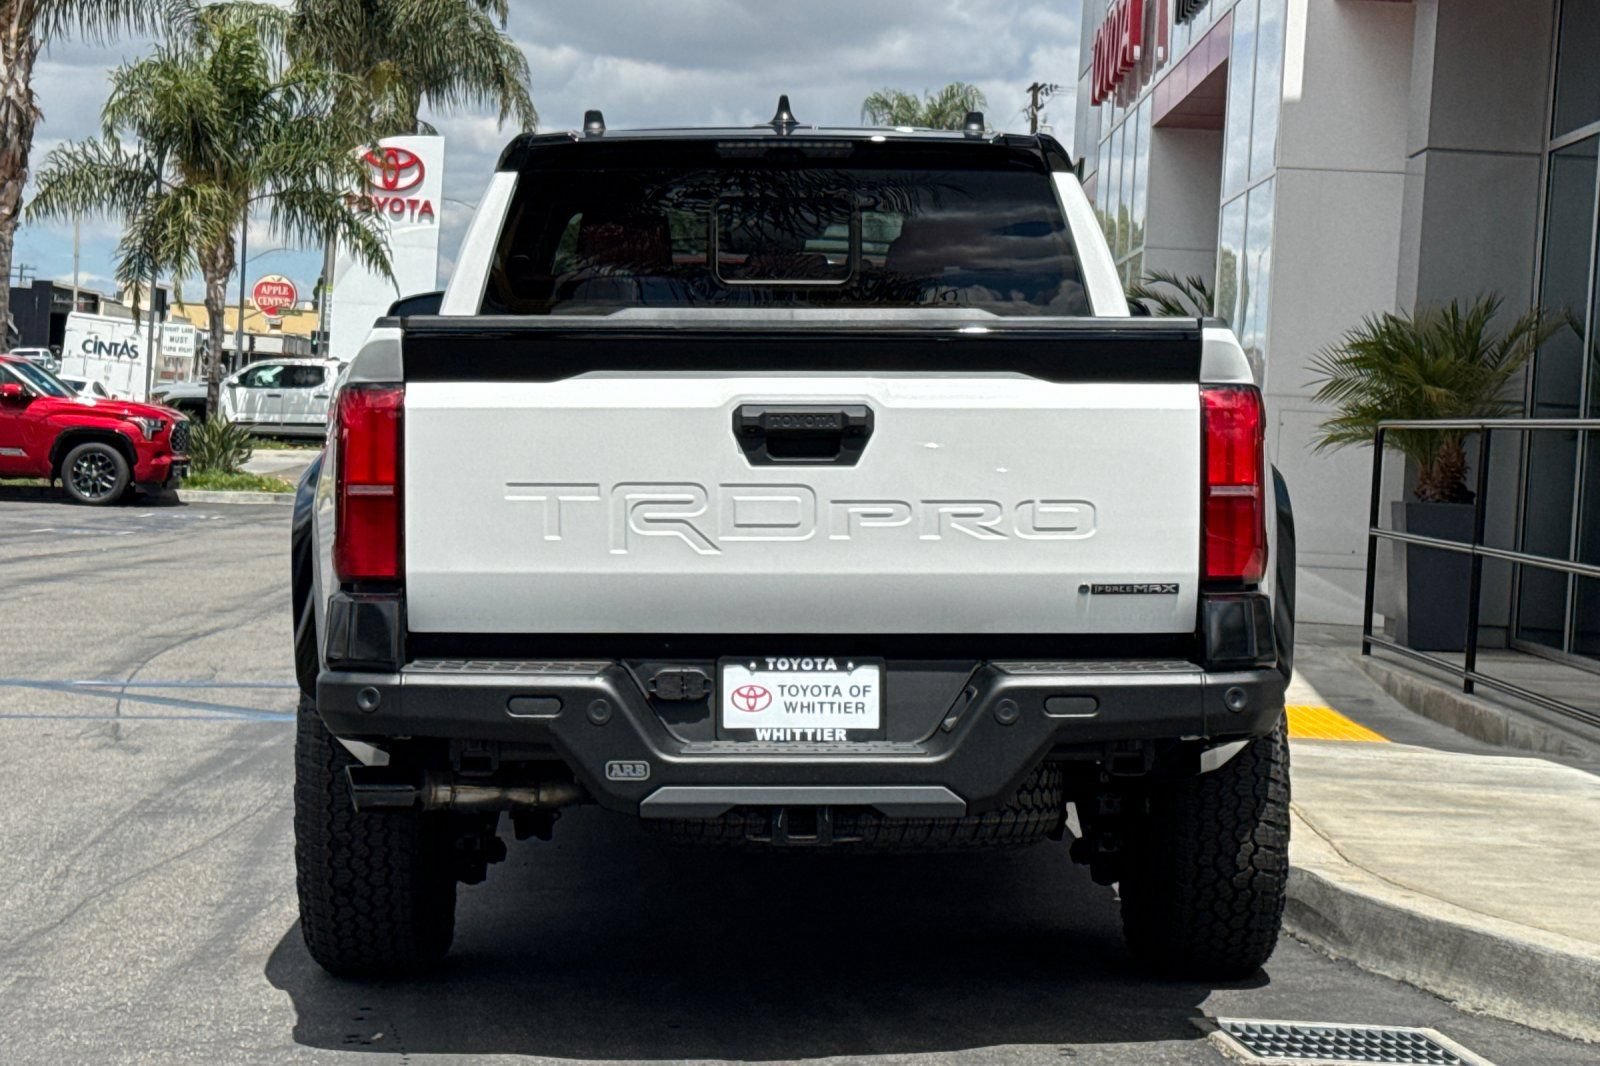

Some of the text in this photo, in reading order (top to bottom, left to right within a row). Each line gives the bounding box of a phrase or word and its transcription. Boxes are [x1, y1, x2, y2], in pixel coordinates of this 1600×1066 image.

[260, 284, 290, 296] APPLE
[257, 296, 292, 307] CENTER
[769, 414, 839, 428] TOYOTA
[504, 482, 1097, 555] TRD PRO
[765, 658, 838, 671] TOYOTA
[777, 684, 872, 697] TOYOTA OF
[783, 701, 866, 715] WHITTIER
[755, 728, 847, 741] WHITTIER
[610, 764, 647, 778] ARB
